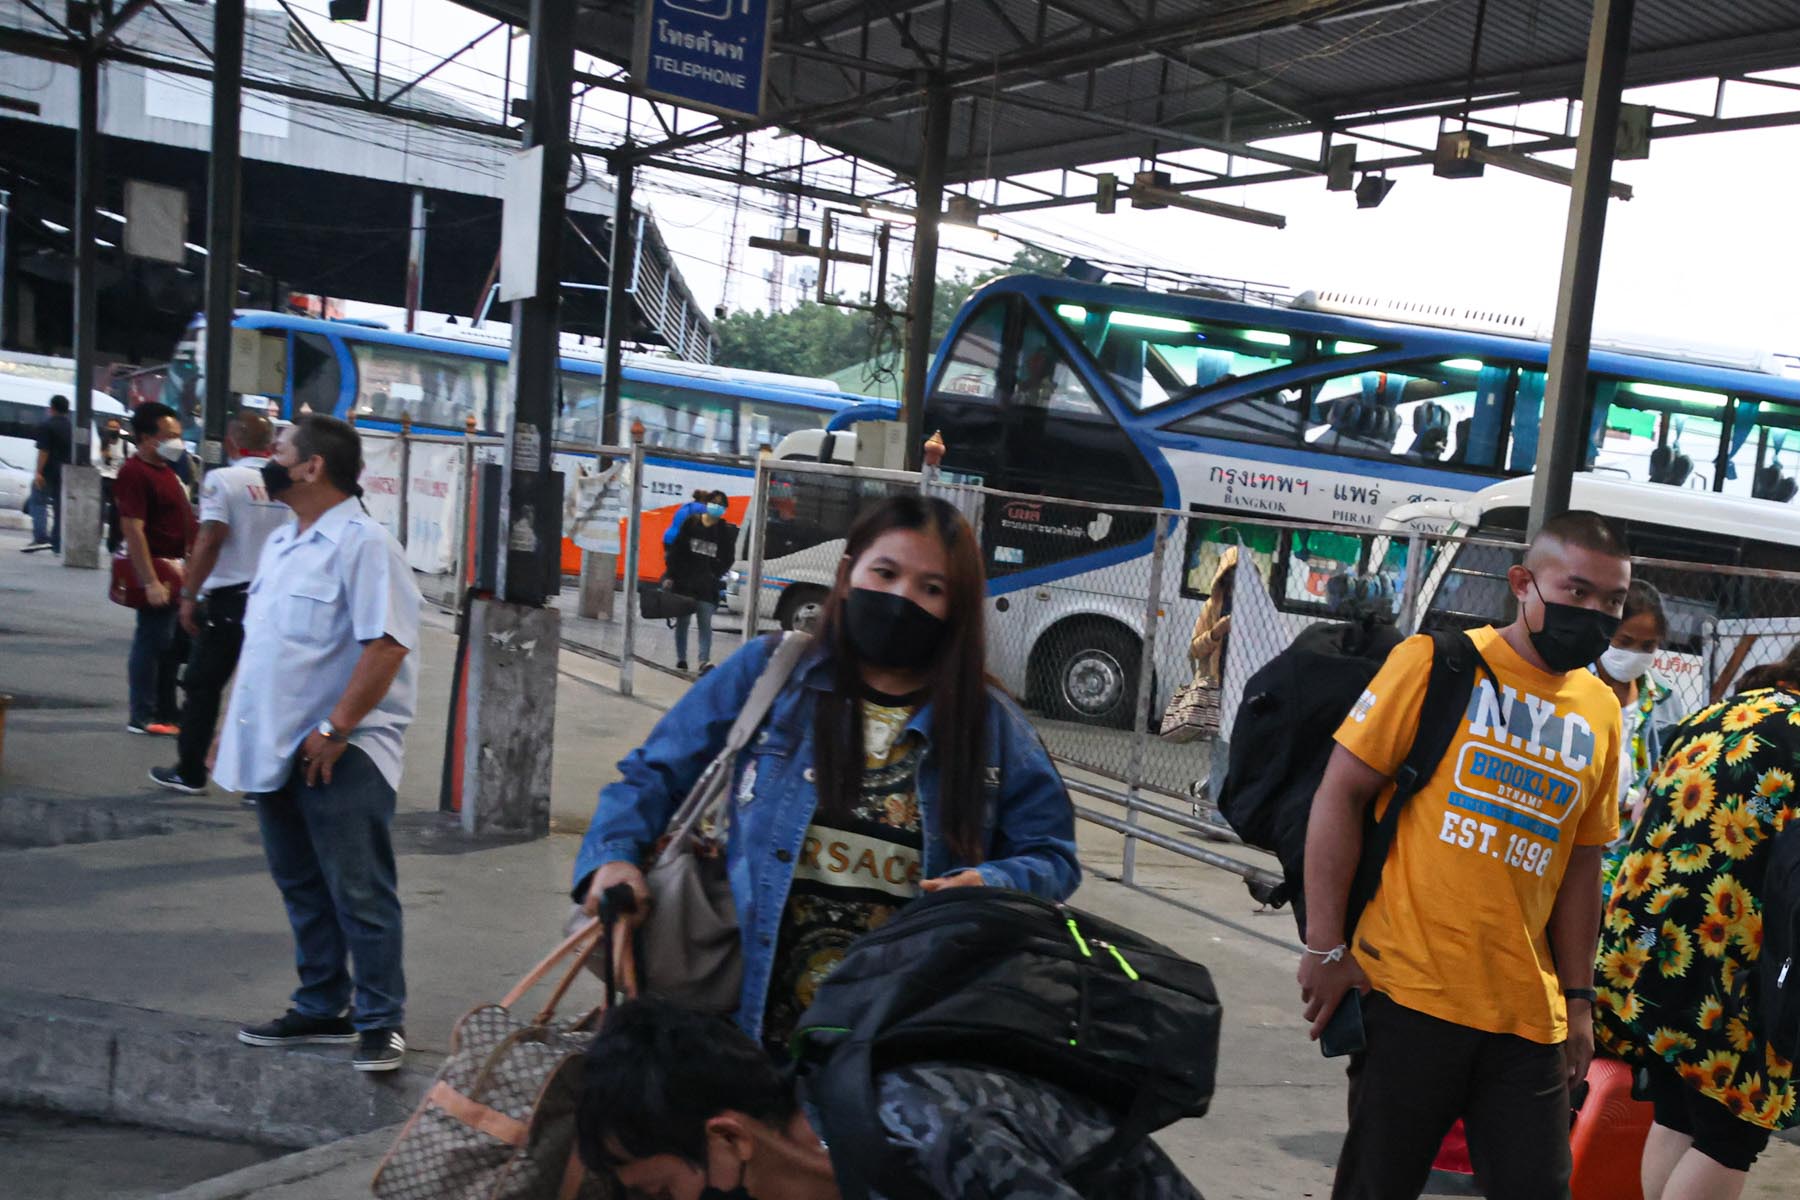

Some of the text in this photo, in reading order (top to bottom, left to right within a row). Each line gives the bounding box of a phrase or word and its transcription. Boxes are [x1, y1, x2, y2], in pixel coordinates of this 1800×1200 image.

[657, 18, 748, 61] โทรศัพท์
[653, 55, 747, 89] TELEPHONE
[1209, 466, 1309, 495] กรุงเทพฯ
[1333, 482, 1382, 506] แพร่
[1223, 493, 1287, 513] BANGKOK
[1469, 751, 1575, 806] BROOKLYN
[1439, 810, 1499, 858] EST.
[1503, 833, 1553, 877] 1998
